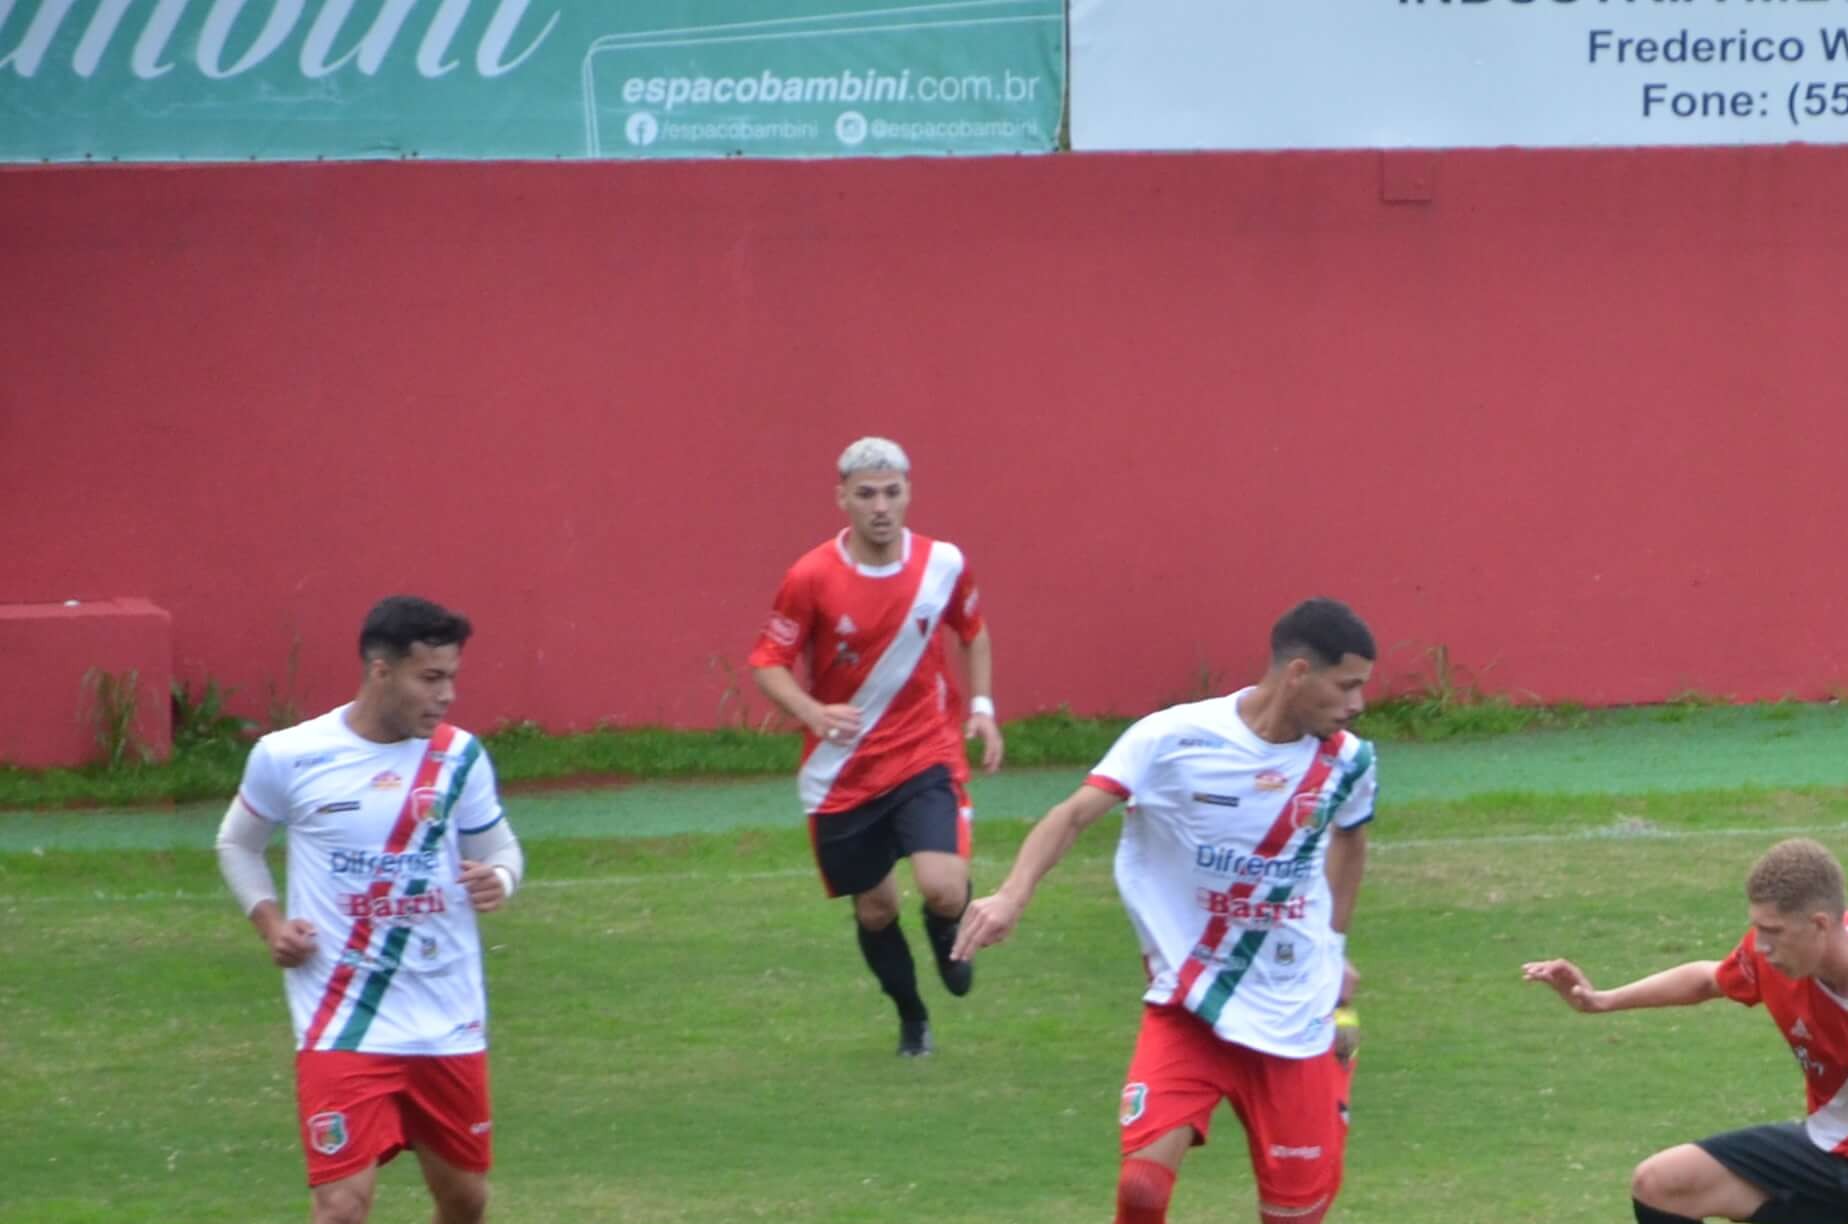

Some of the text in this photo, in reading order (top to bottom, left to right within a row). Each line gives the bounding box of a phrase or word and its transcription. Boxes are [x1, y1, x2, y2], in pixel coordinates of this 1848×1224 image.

[1588, 29, 1806, 64] Frederico
[622, 69, 1040, 111] espacobambini.com.br
[1642, 82, 1769, 118] Fone:
